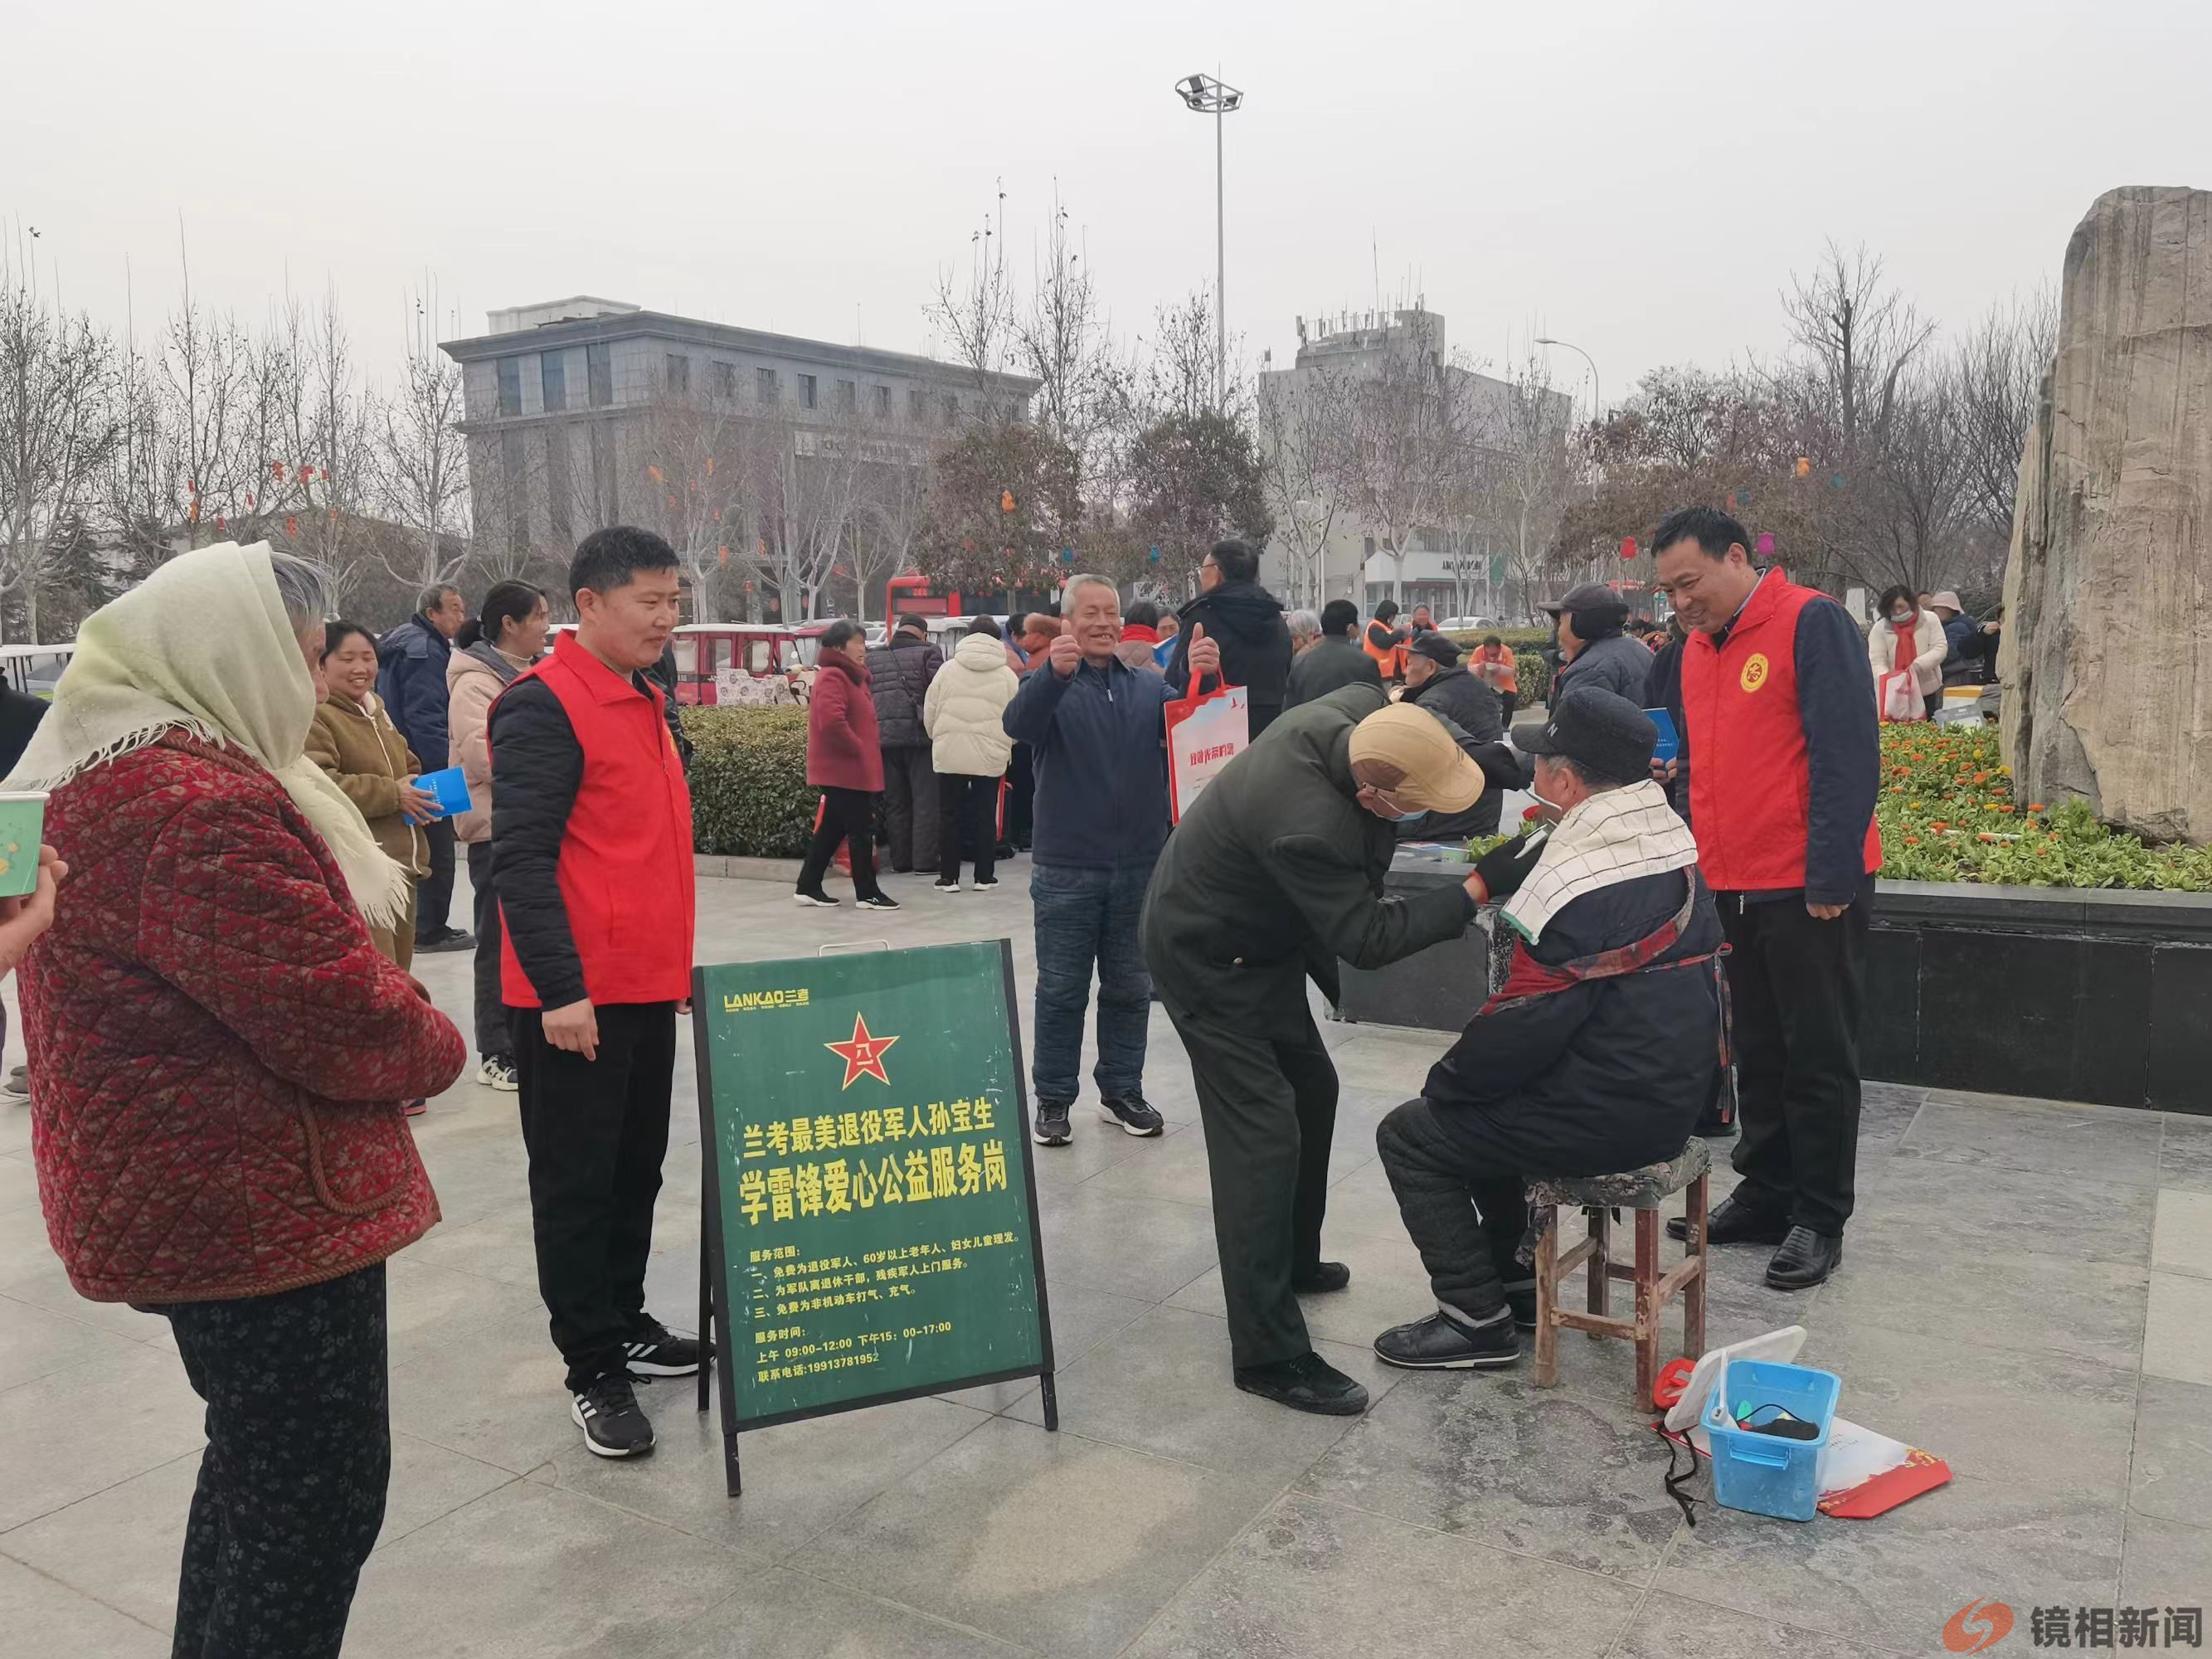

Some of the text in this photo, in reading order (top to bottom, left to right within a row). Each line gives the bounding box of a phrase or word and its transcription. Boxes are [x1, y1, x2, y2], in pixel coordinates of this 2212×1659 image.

[743, 1097, 995, 1159] 兰考最美退役军人孙宝生
[739, 1139, 1008, 1226] 学雷锋爱心公益服务岗
[756, 1350, 780, 1365] 上午
[785, 1338, 853, 1359] 09:00-12:00
